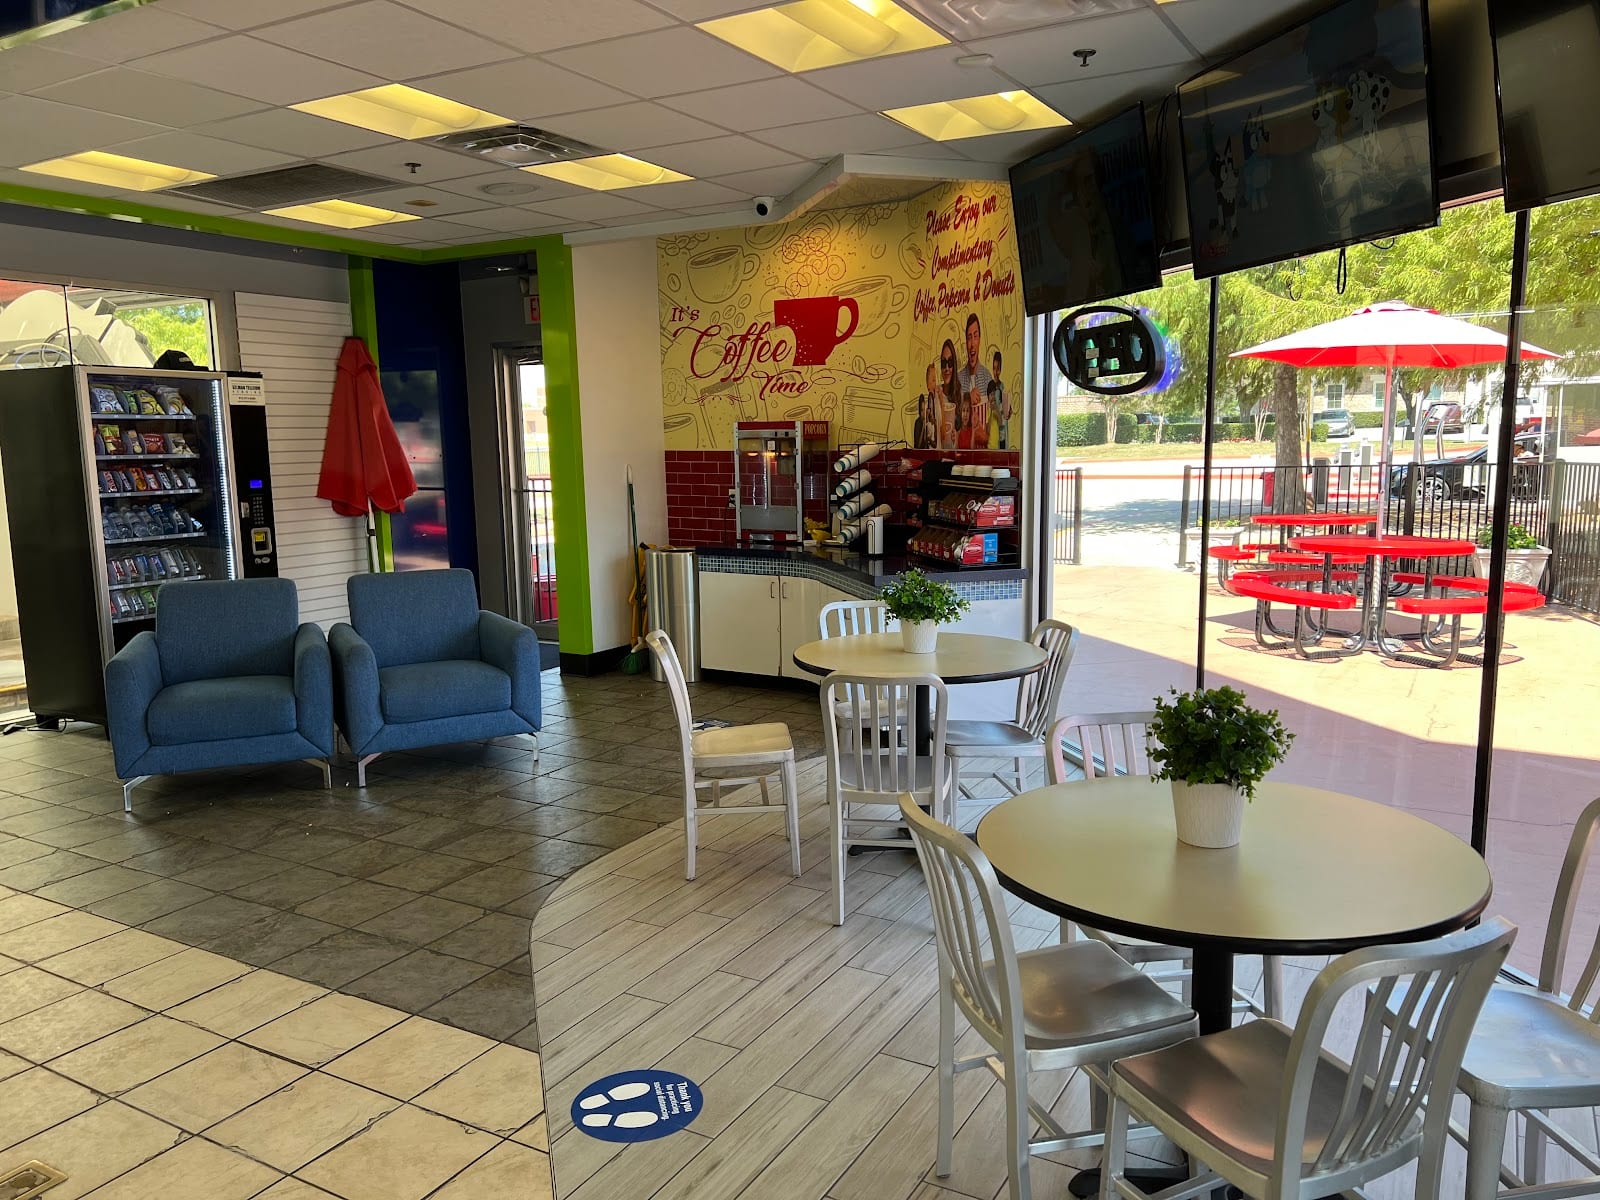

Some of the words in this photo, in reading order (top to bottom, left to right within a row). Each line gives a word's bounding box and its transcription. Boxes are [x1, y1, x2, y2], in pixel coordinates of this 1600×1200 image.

[926, 210, 951, 241] Please
[953, 194, 980, 233] Enjoy
[982, 194, 997, 216] our
[931, 237, 993, 280] Complimentary
[938, 282, 970, 315] Popcorn
[973, 271, 981, 302] &
[982, 269, 1015, 301] Donuts
[670, 305, 700, 322] It's
[672, 321, 792, 383] Coffee
[751, 370, 809, 401] Time
[804, 423, 827, 435] POPCORN
[677, 1081, 691, 1101] Thank
[680, 1101, 692, 1112] you
